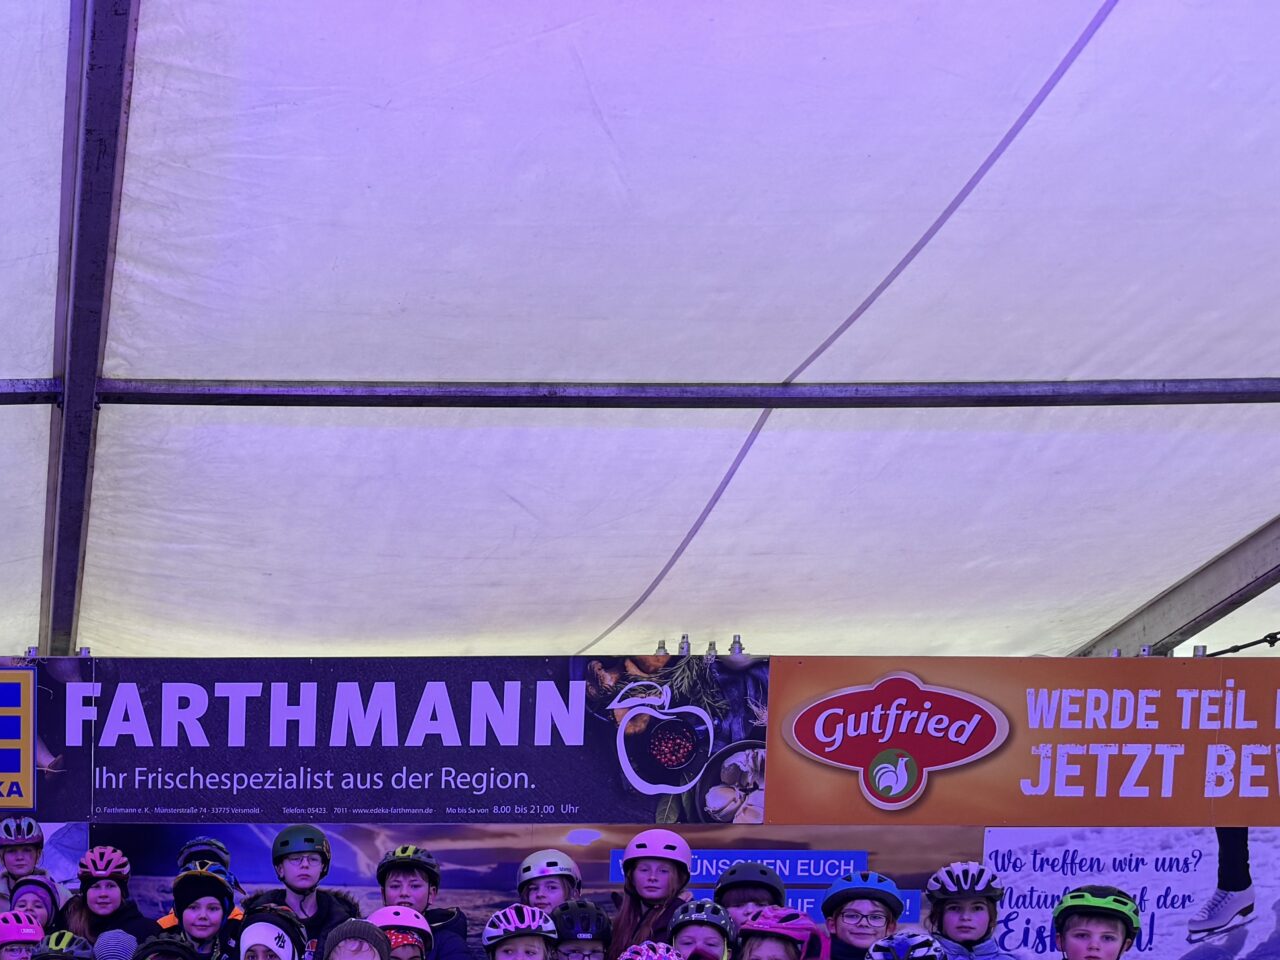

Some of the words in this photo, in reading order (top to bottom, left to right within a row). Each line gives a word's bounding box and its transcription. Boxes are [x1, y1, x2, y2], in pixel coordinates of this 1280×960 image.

[65, 680, 587, 747] FARTHMANN
[1026, 688, 1161, 729] WERDE
[814, 697, 982, 752] Gutfried
[95, 767, 126, 789] Ihr
[135, 767, 334, 795] Frischespezialist
[340, 771, 383, 790] aus
[391, 766, 433, 790] der
[441, 767, 536, 795] Region.
[1020, 743, 1185, 798] JETZT
[1204, 743, 1280, 798] BE
[493, 805, 511, 814] 8.00
[514, 805, 528, 814] bis
[529, 805, 555, 814] 21.00
[561, 804, 579, 814] Uhr
[797, 860, 854, 876] EUCH
[989, 849, 1027, 872] Wo
[1030, 849, 1106, 876] treffen
[1112, 853, 1148, 872] wir
[1154, 849, 1203, 873] uns?
[1156, 886, 1194, 909] der
